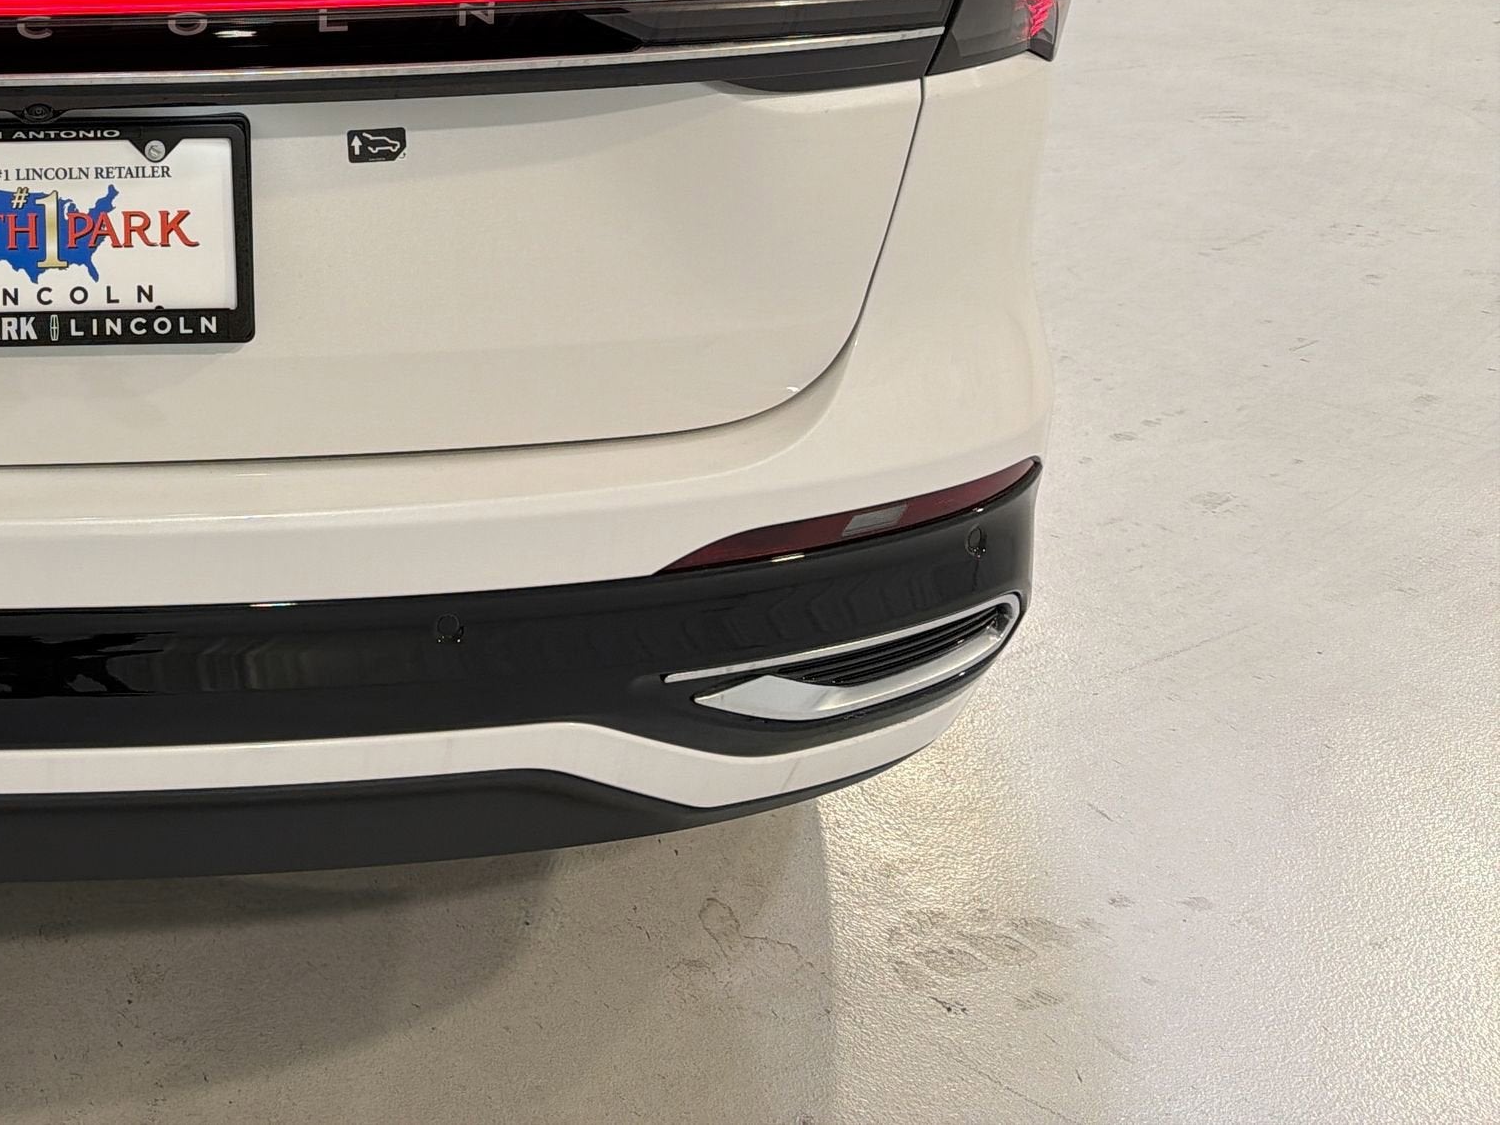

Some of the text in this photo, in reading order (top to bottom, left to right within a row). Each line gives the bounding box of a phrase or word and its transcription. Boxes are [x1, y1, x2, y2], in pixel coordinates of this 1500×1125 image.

[12, 129, 120, 139] ANTONIO
[14, 167, 90, 181] LINCOLN
[94, 165, 172, 180] RETAILER
[67, 210, 200, 249] PARK
[70, 315, 217, 337] LINCOLN
